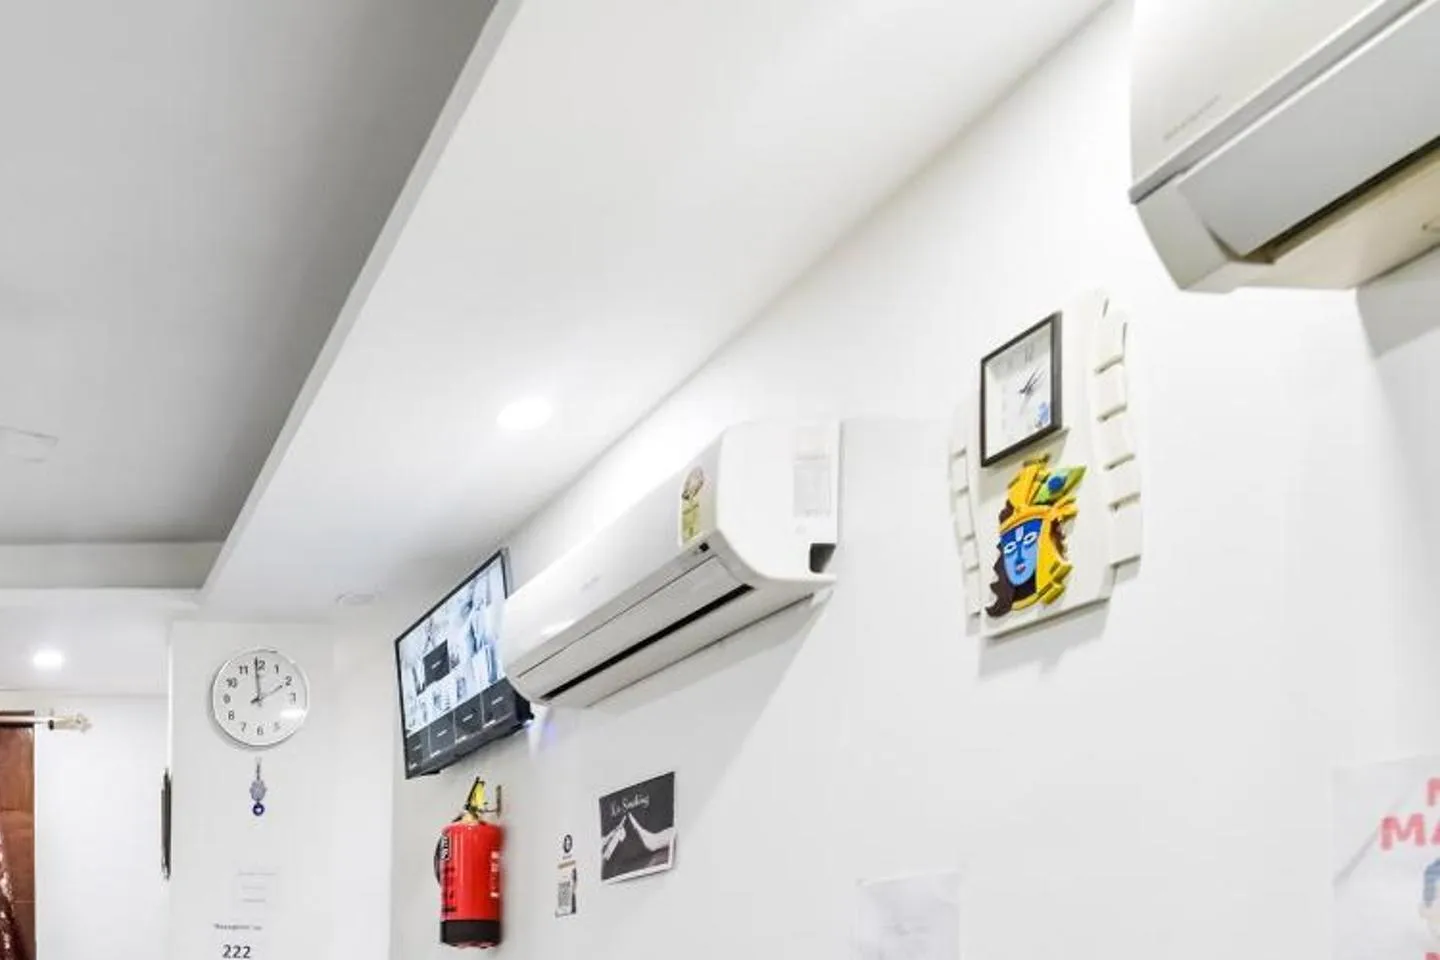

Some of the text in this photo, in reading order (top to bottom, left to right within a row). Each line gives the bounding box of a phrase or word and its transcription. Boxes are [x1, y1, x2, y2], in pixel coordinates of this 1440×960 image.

[239, 665, 249, 675] 11
[226, 677, 238, 688] 10
[285, 675, 292, 687] 2
[222, 944, 251, 959] 222
